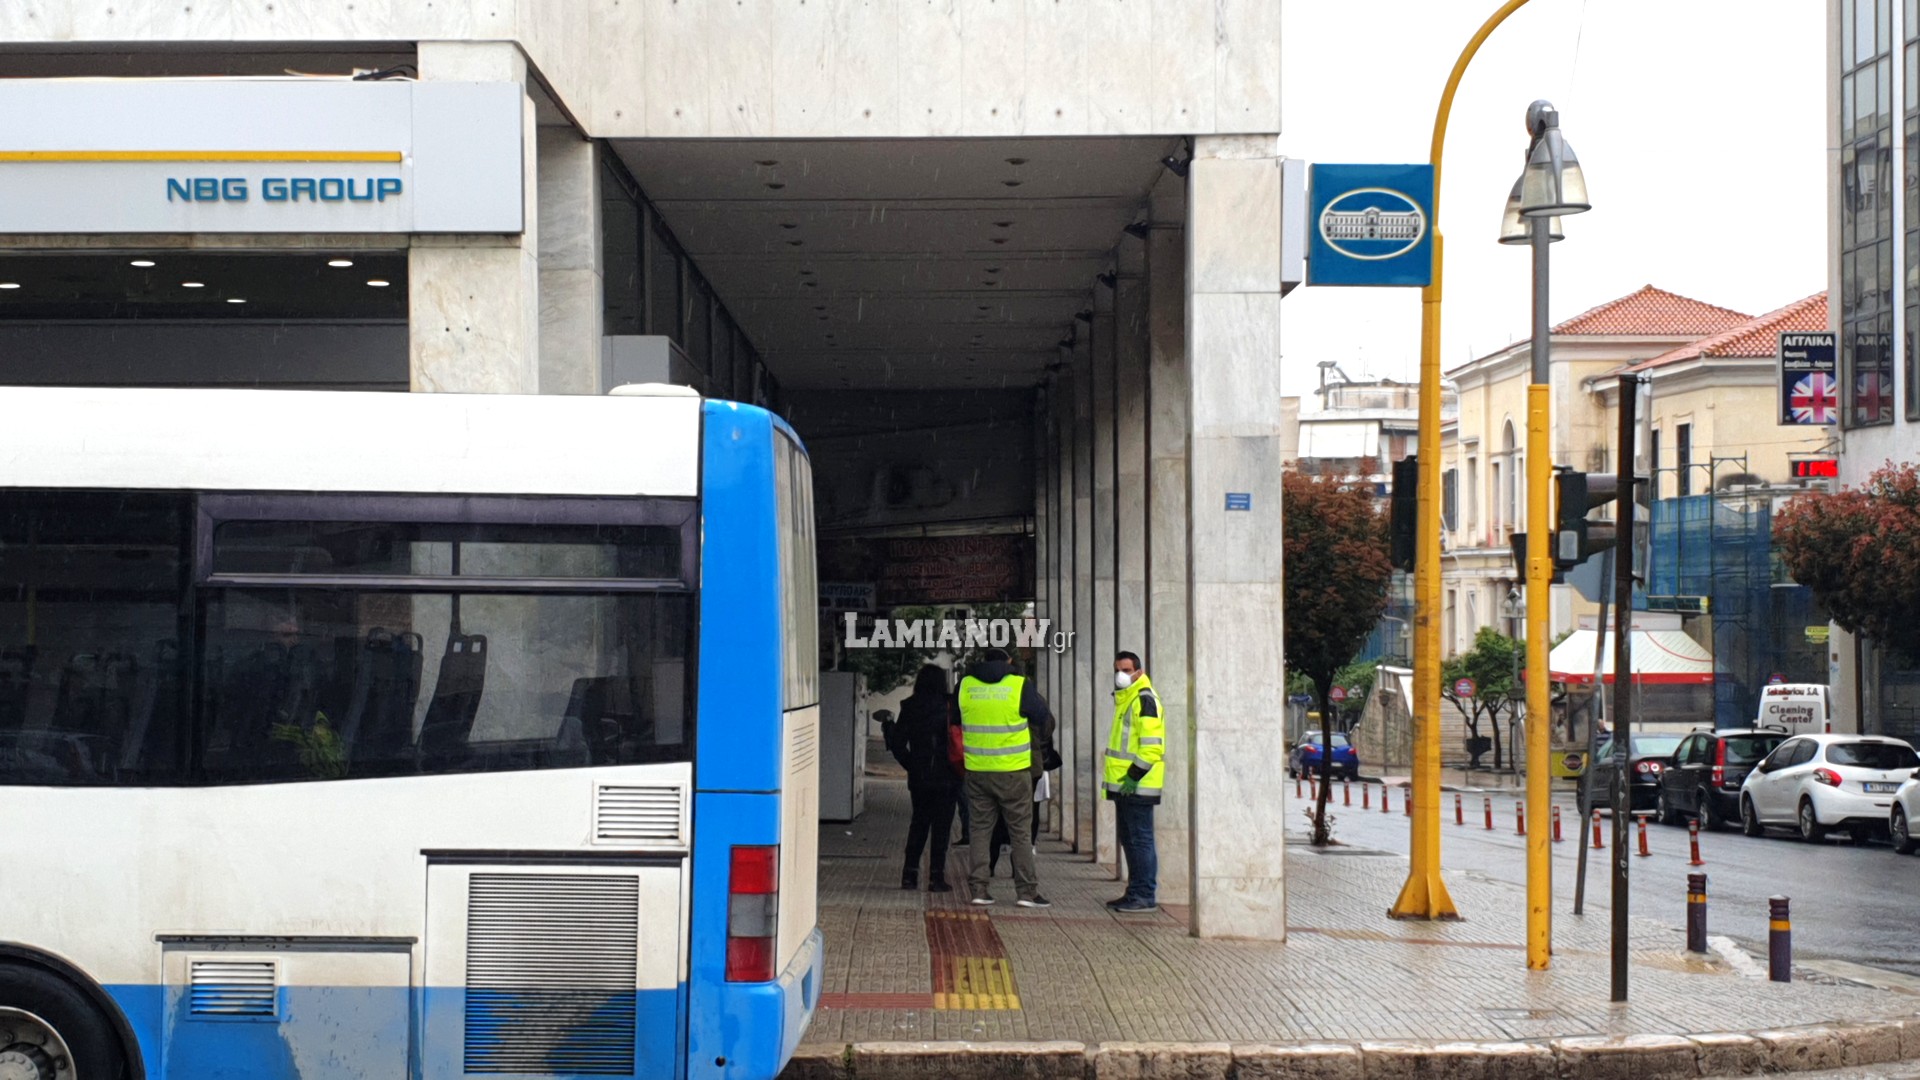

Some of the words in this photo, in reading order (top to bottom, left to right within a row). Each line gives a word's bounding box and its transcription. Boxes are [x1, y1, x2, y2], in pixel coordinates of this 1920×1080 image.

[166, 177, 248, 202] NBG
[262, 177, 403, 202] GROUP
[1783, 335, 1833, 347] ΑΓΓΛΙΚΑ
[1769, 704, 1814, 717] Cleaning
[1779, 714, 1813, 724] Center
